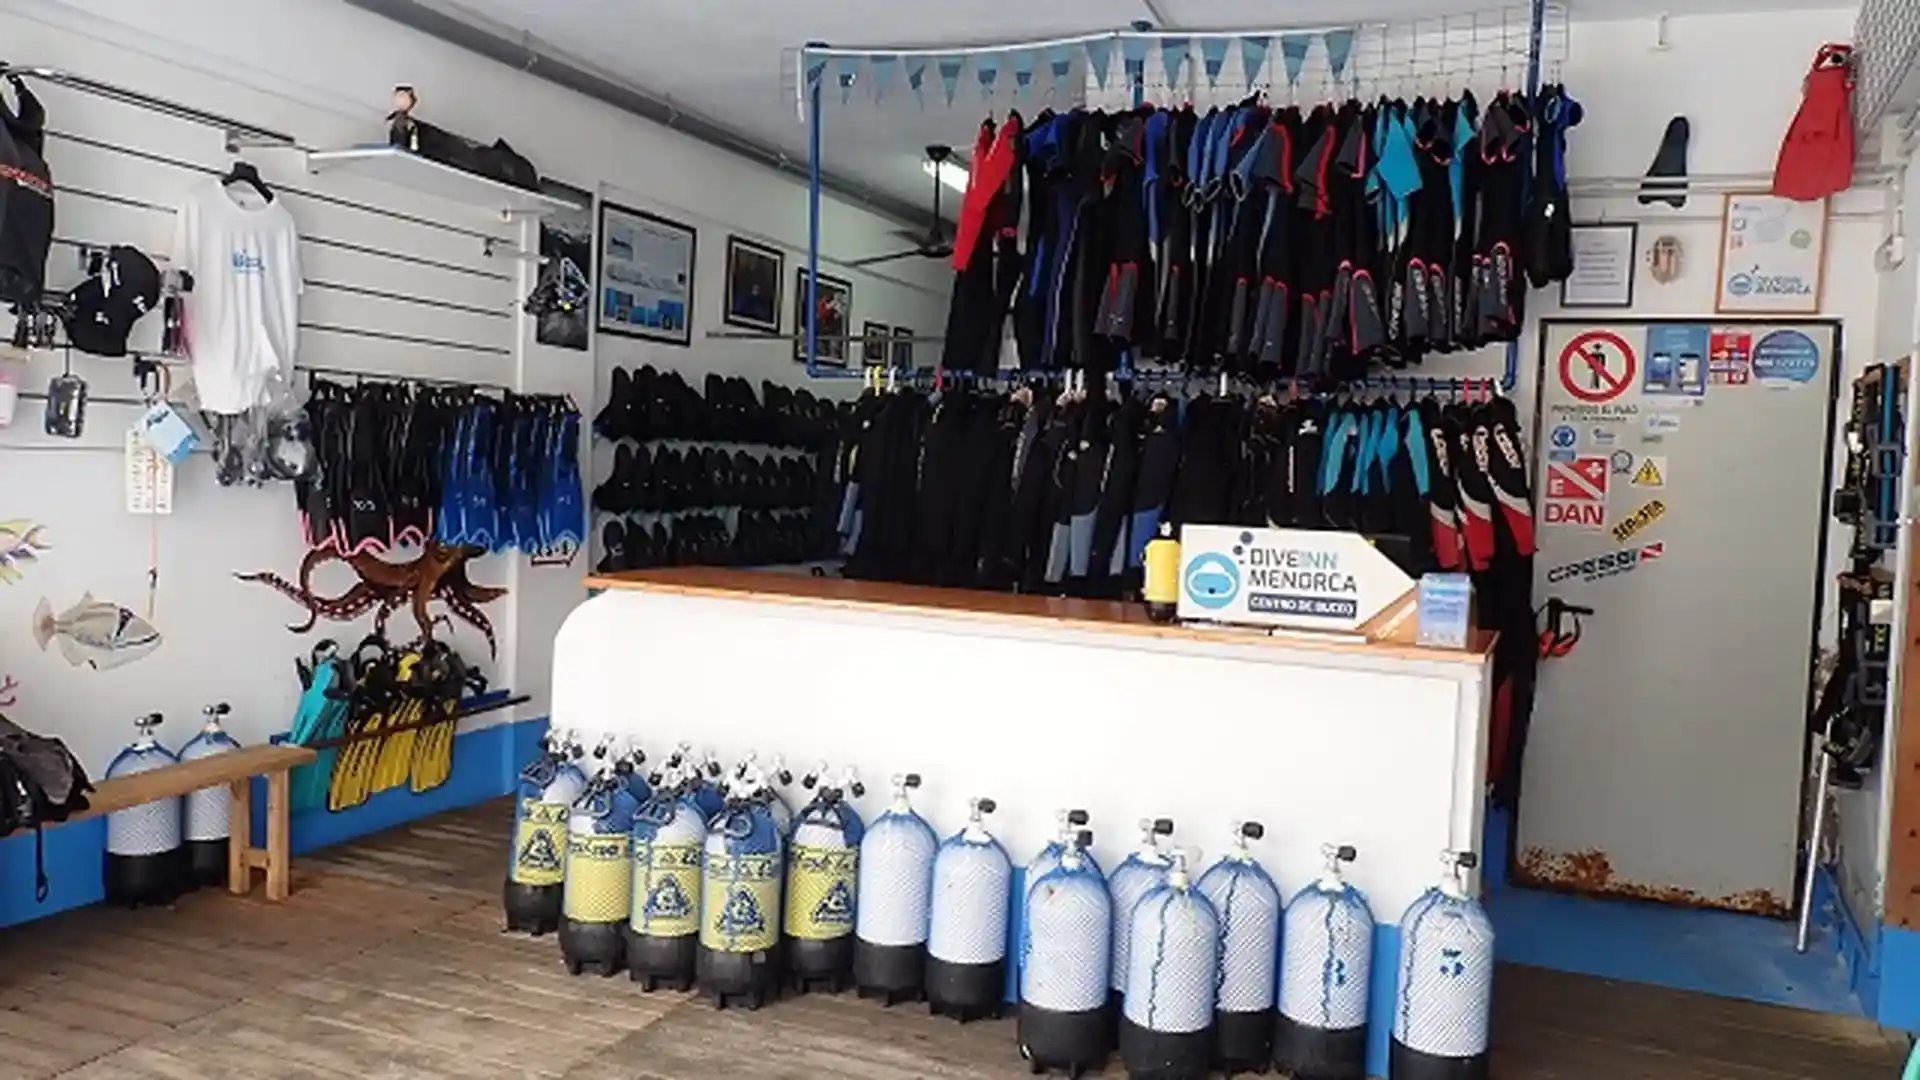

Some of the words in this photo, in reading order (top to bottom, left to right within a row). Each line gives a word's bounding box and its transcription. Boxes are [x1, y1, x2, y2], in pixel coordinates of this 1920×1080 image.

[1550, 478, 1564, 496] E
[1544, 503, 1604, 525] DAN
[1250, 547, 1338, 570] DIVEINN
[1248, 568, 1357, 593] MENORCA
[1250, 596, 1297, 611] CENTRO
[1314, 602, 1354, 616] BUCEO
